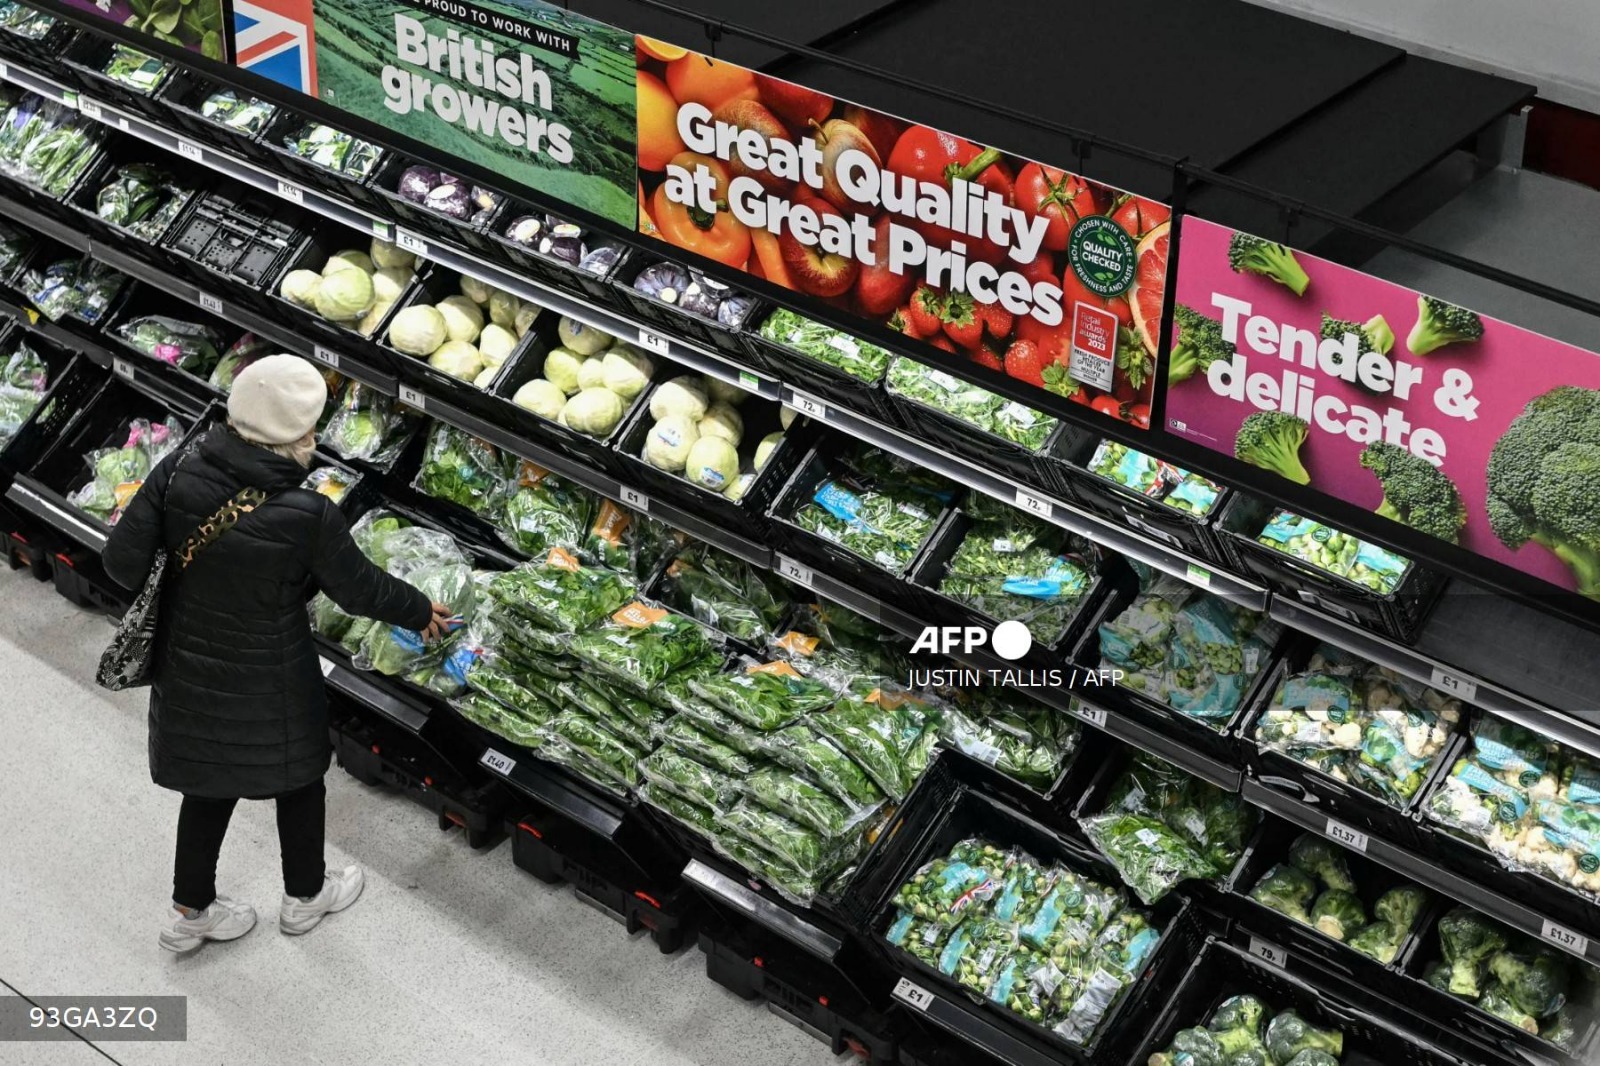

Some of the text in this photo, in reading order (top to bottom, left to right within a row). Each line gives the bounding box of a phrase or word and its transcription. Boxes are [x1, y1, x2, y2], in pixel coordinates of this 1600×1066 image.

[471, 9, 488, 25] TO
[492, 16, 531, 39] WORK
[536, 31, 570, 51] WITH
[394, 13, 553, 112] British
[381, 64, 574, 164] growers
[676, 102, 1050, 265] Great Quality
[664, 163, 1064, 327] at Great Prices
[1074, 219, 1133, 257] CHOSEN WITH CARE
[1082, 240, 1123, 262] QUALITY
[1070, 244, 1134, 293] FOR FRESHNESS AND TASTE
[1081, 252, 1121, 272] CHECKED
[647, 334, 659, 346] £1
[1210, 291, 1481, 422] Tender &
[1206, 353, 1447, 468] delicate
[627, 491, 638, 503] £1
[1442, 675, 1458, 689] £1
[1082, 706, 1096, 720] £1
[1332, 826, 1356, 843] £1.37
[1551, 928, 1577, 945] £1.37
[908, 989, 923, 1003] £1
